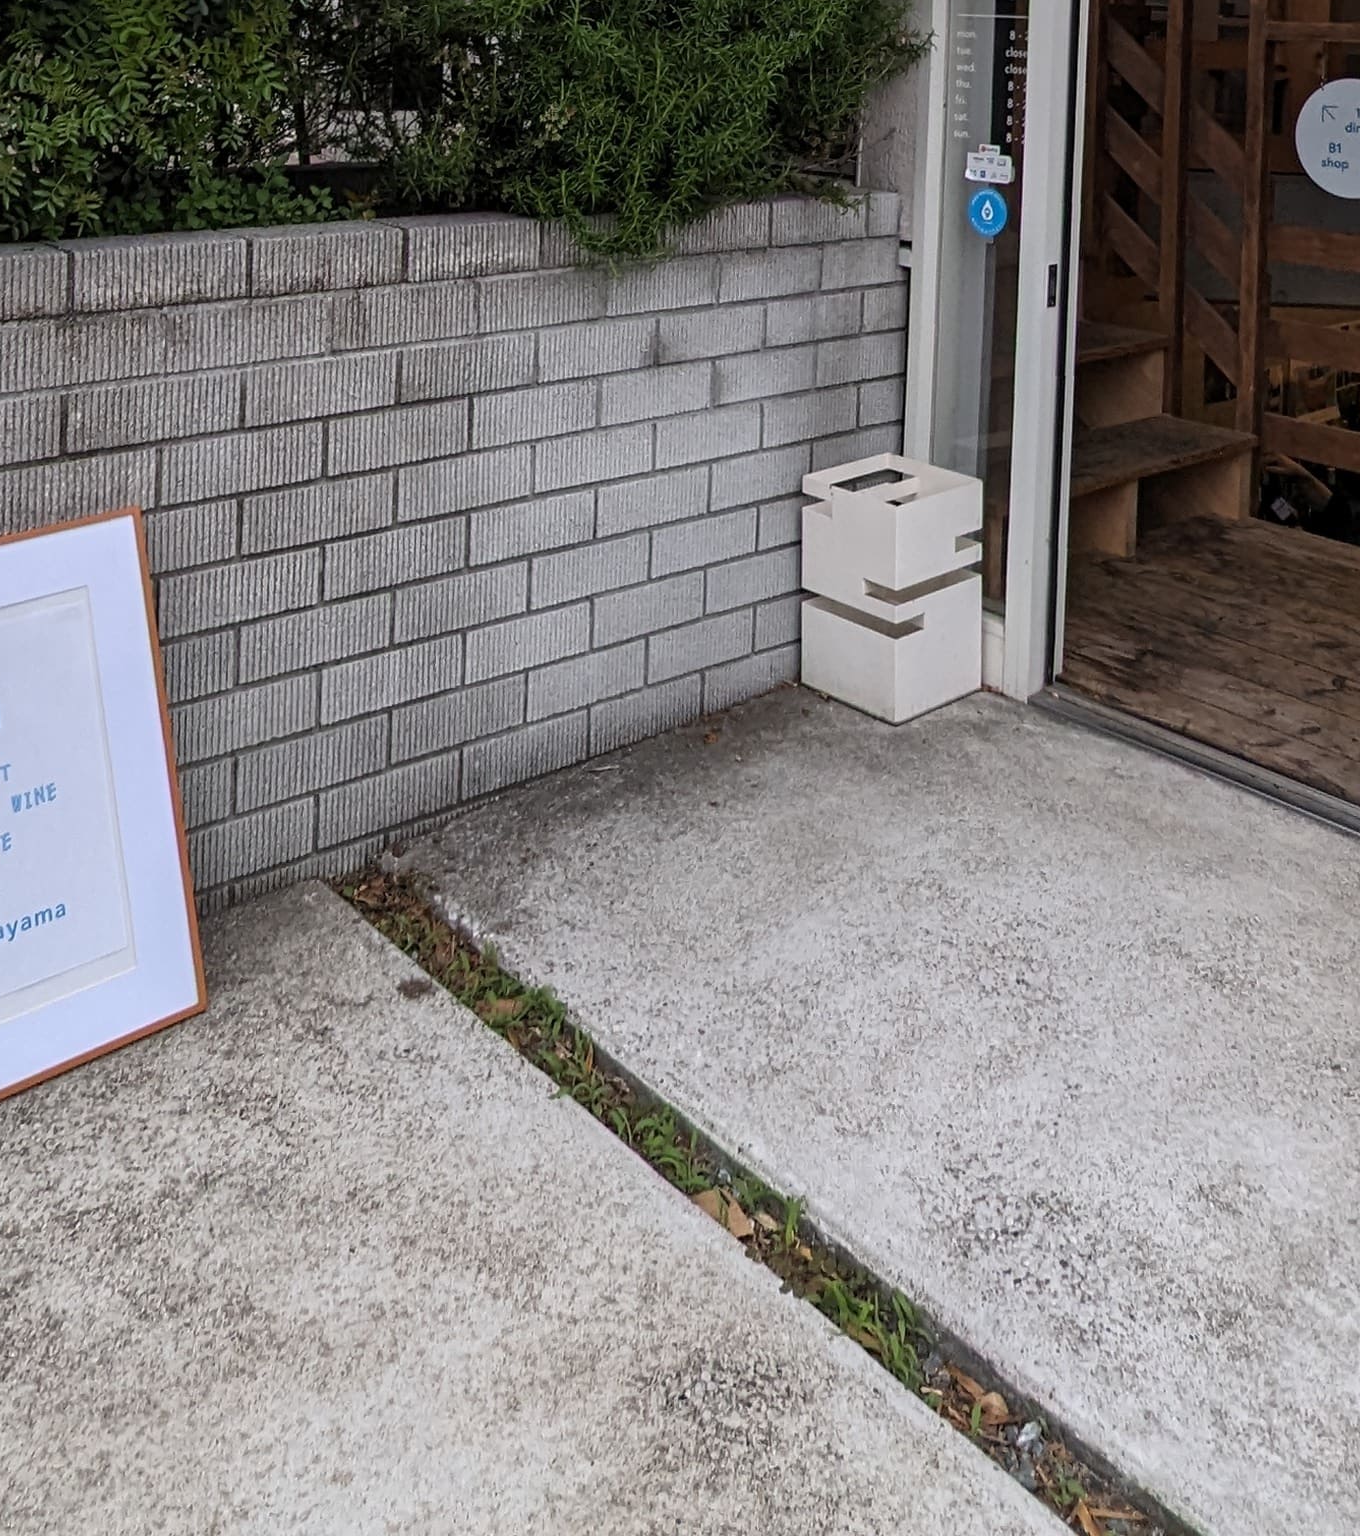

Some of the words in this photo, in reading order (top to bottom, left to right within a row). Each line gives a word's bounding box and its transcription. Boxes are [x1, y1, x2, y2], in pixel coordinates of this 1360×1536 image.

[1328, 142, 1342, 154] B1
[1321, 157, 1349, 172] shop
[10, 782, 57, 813] WINE
